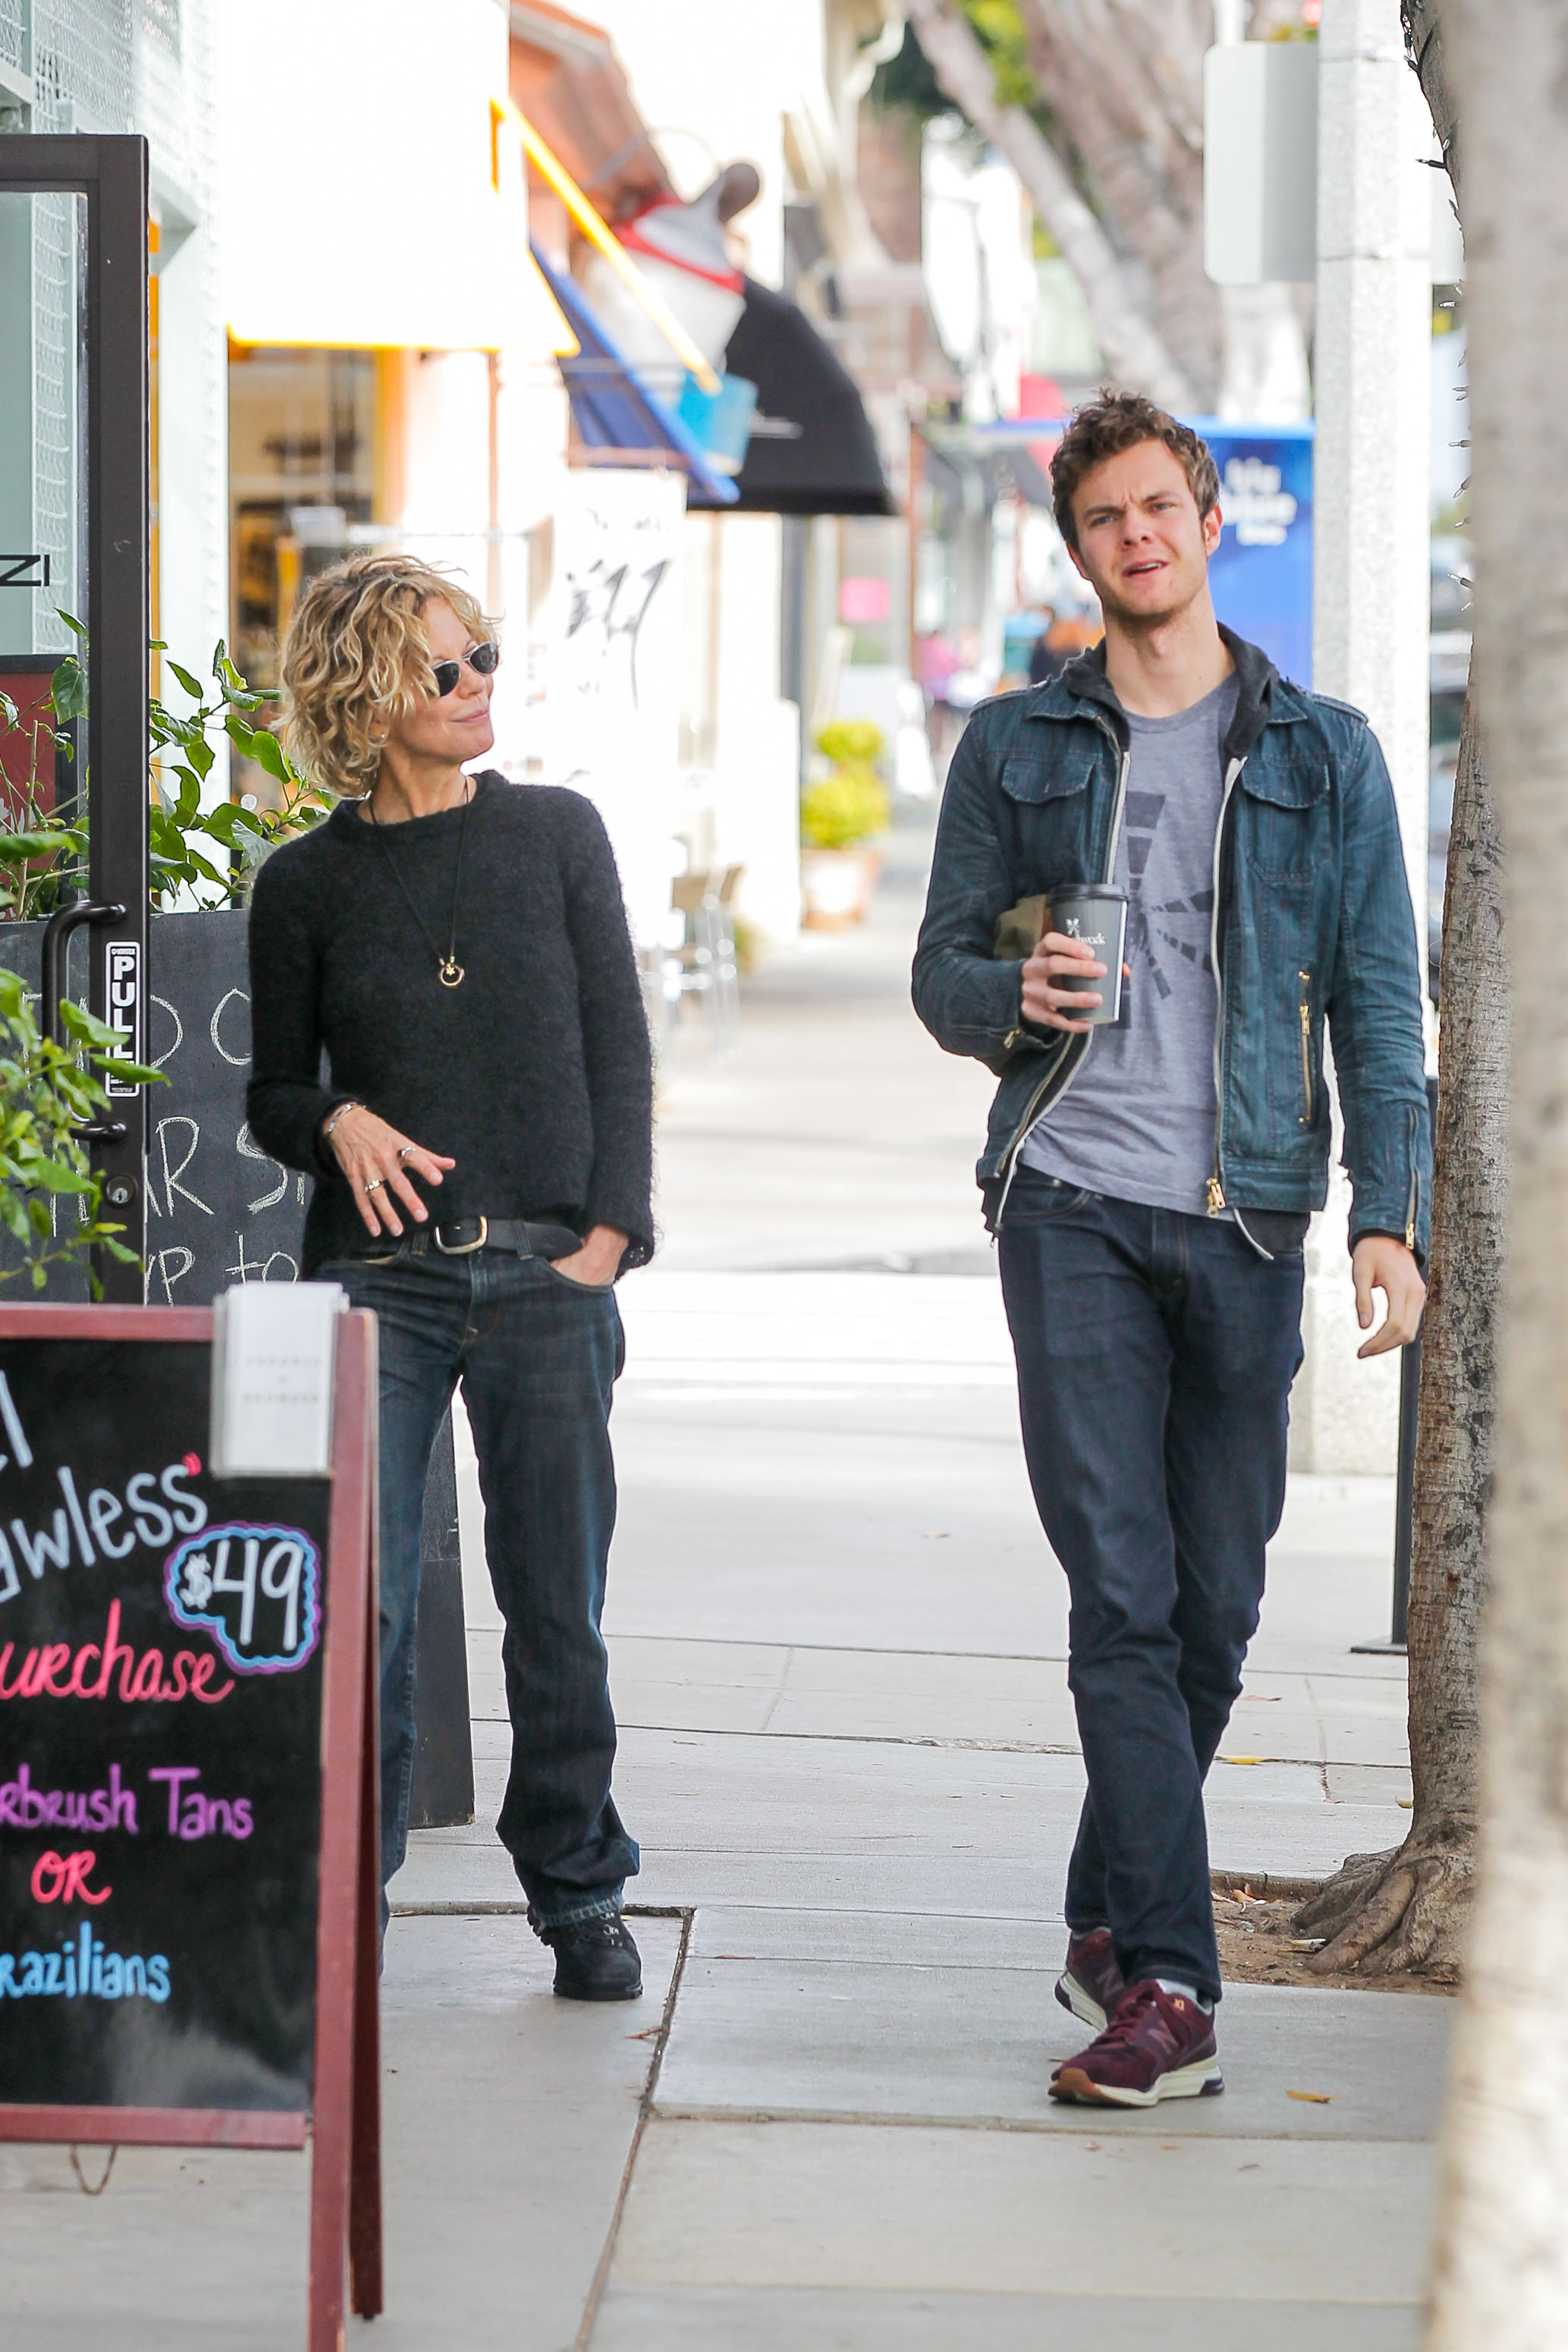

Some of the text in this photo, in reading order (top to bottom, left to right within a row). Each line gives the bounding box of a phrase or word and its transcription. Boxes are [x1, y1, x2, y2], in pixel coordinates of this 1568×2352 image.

[112, 956, 135, 1059] PULL
[180, 1539, 304, 1651] $49
[148, 1766, 254, 1841] Tans
[30, 1850, 112, 1905] OR
